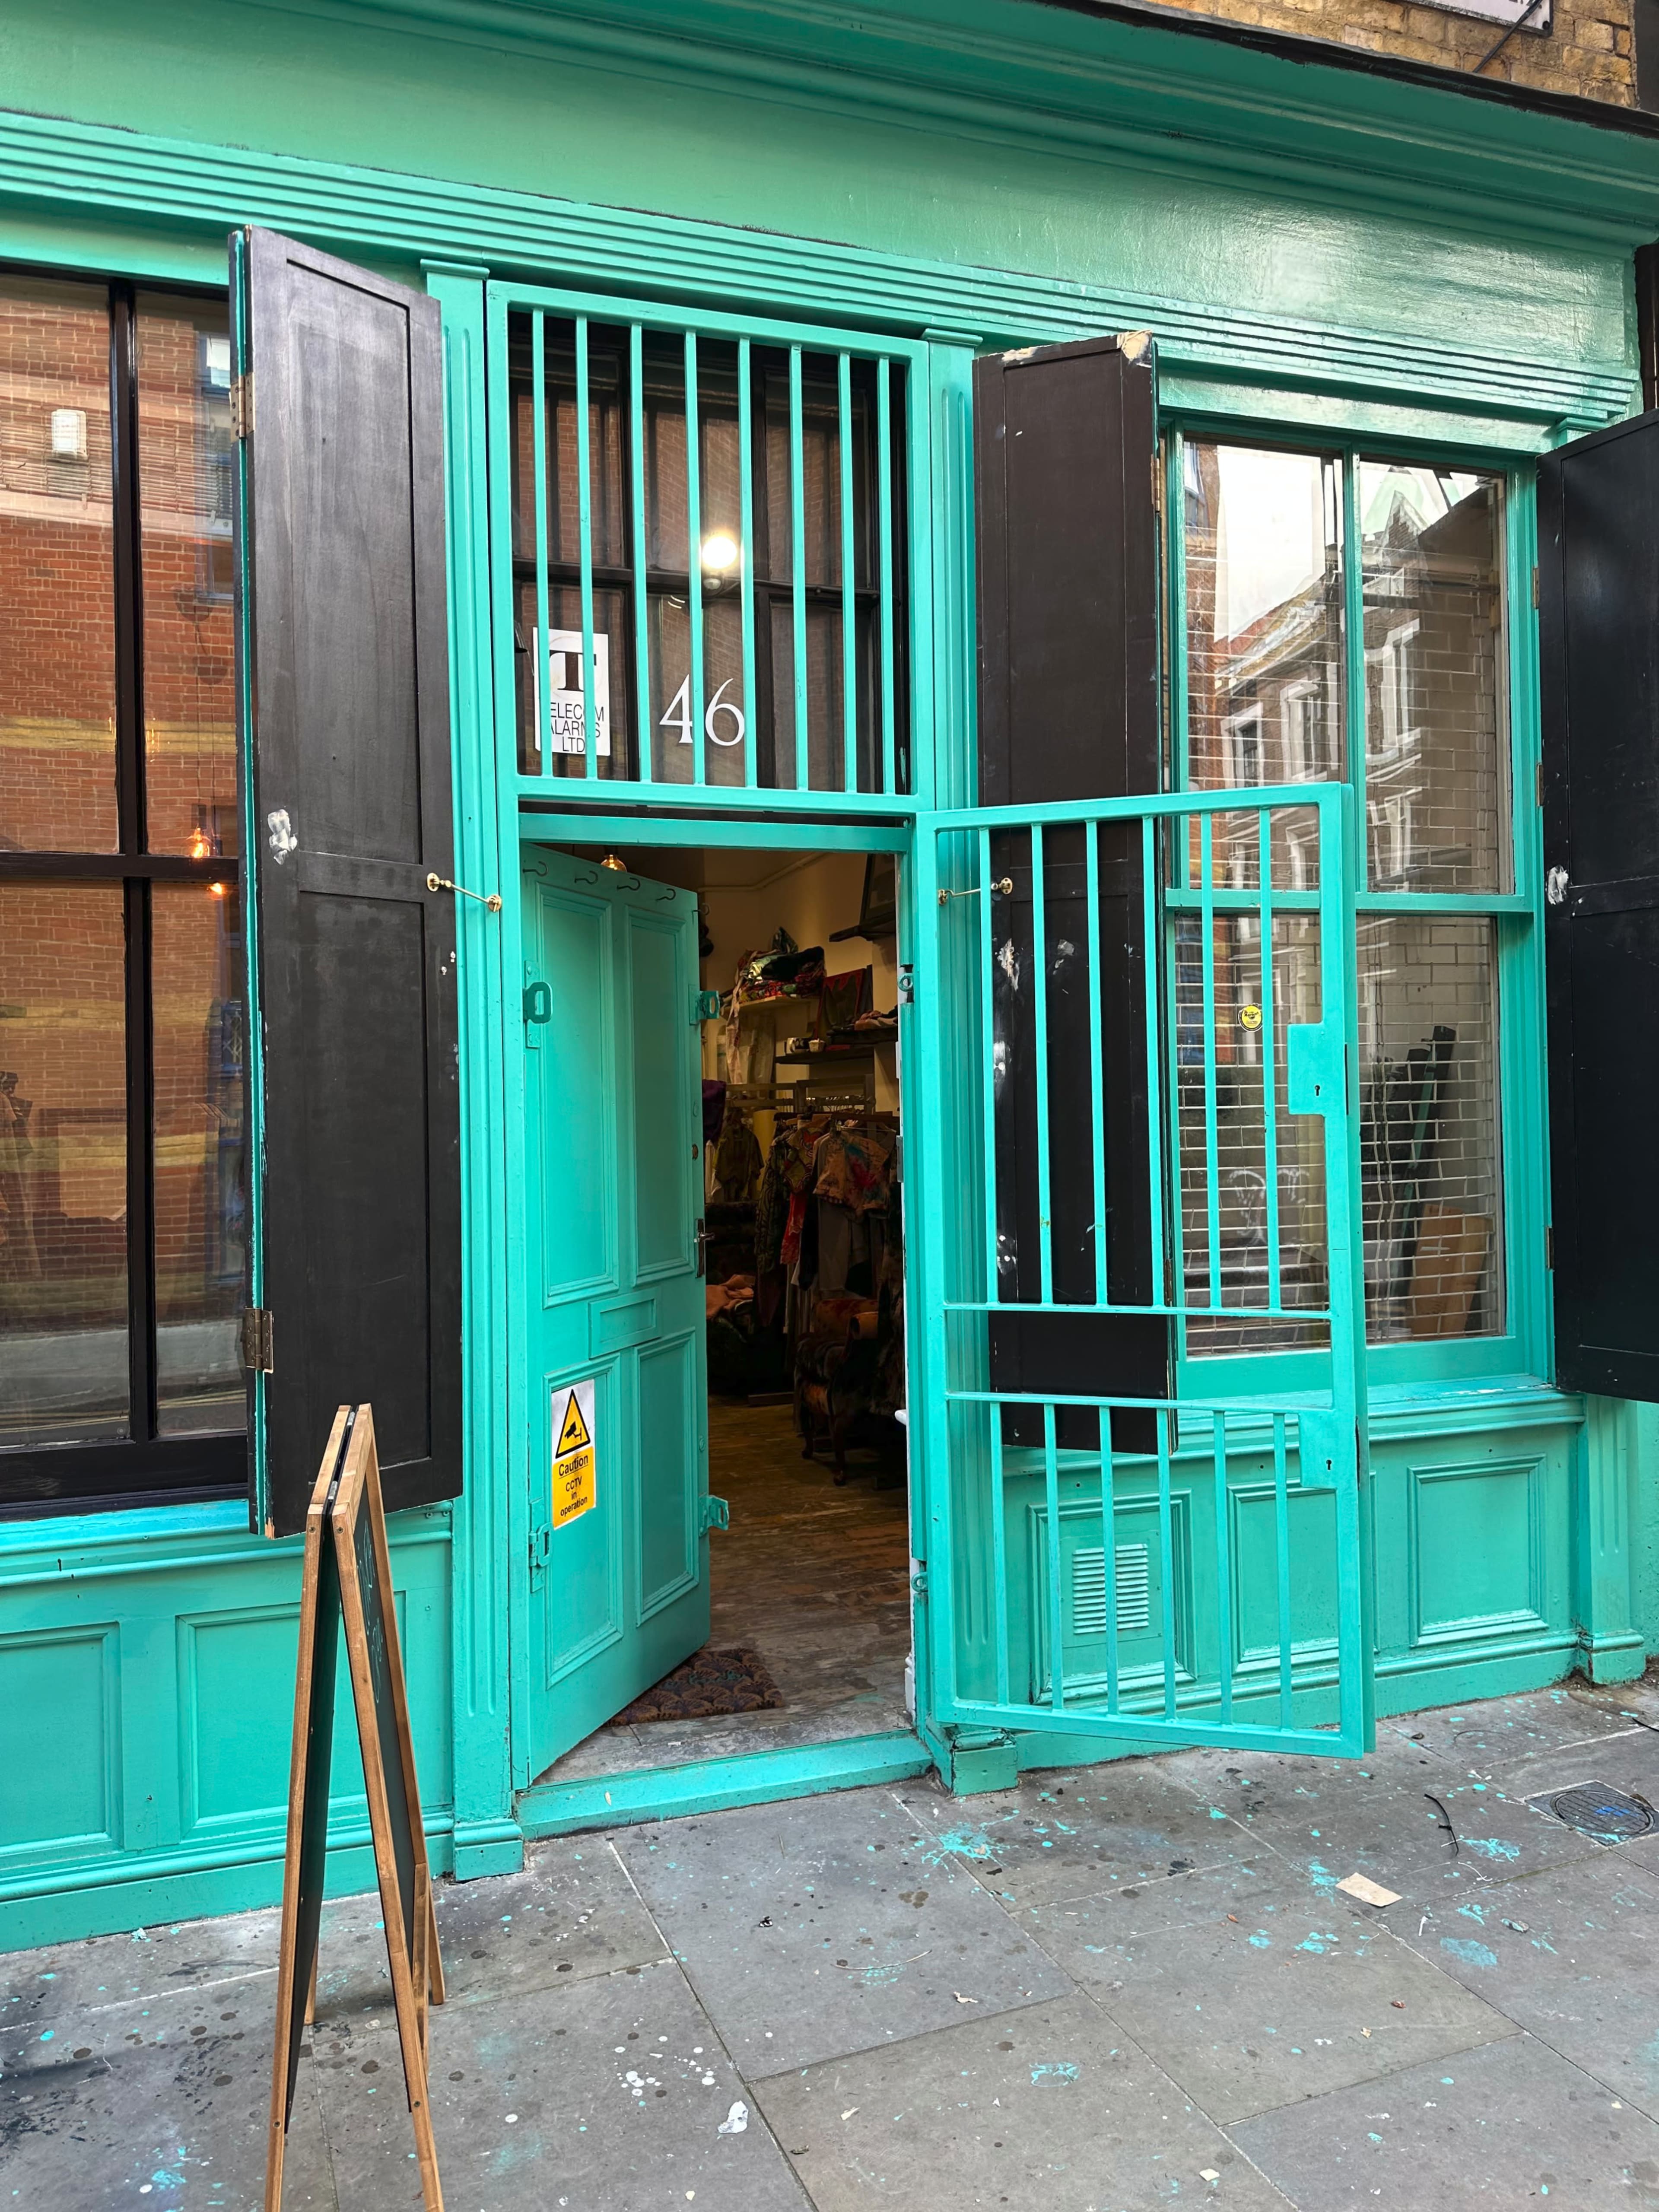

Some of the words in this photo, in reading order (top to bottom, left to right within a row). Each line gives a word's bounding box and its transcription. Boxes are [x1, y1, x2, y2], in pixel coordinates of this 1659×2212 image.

[550, 702, 604, 721] ELECM
[659, 674, 744, 746] 46
[563, 736, 585, 753] LTD
[559, 1455, 588, 1476] Caution
[566, 1475, 582, 1492] CCTV
[571, 1491, 577, 1500] in
[560, 1497, 588, 1517] operation
